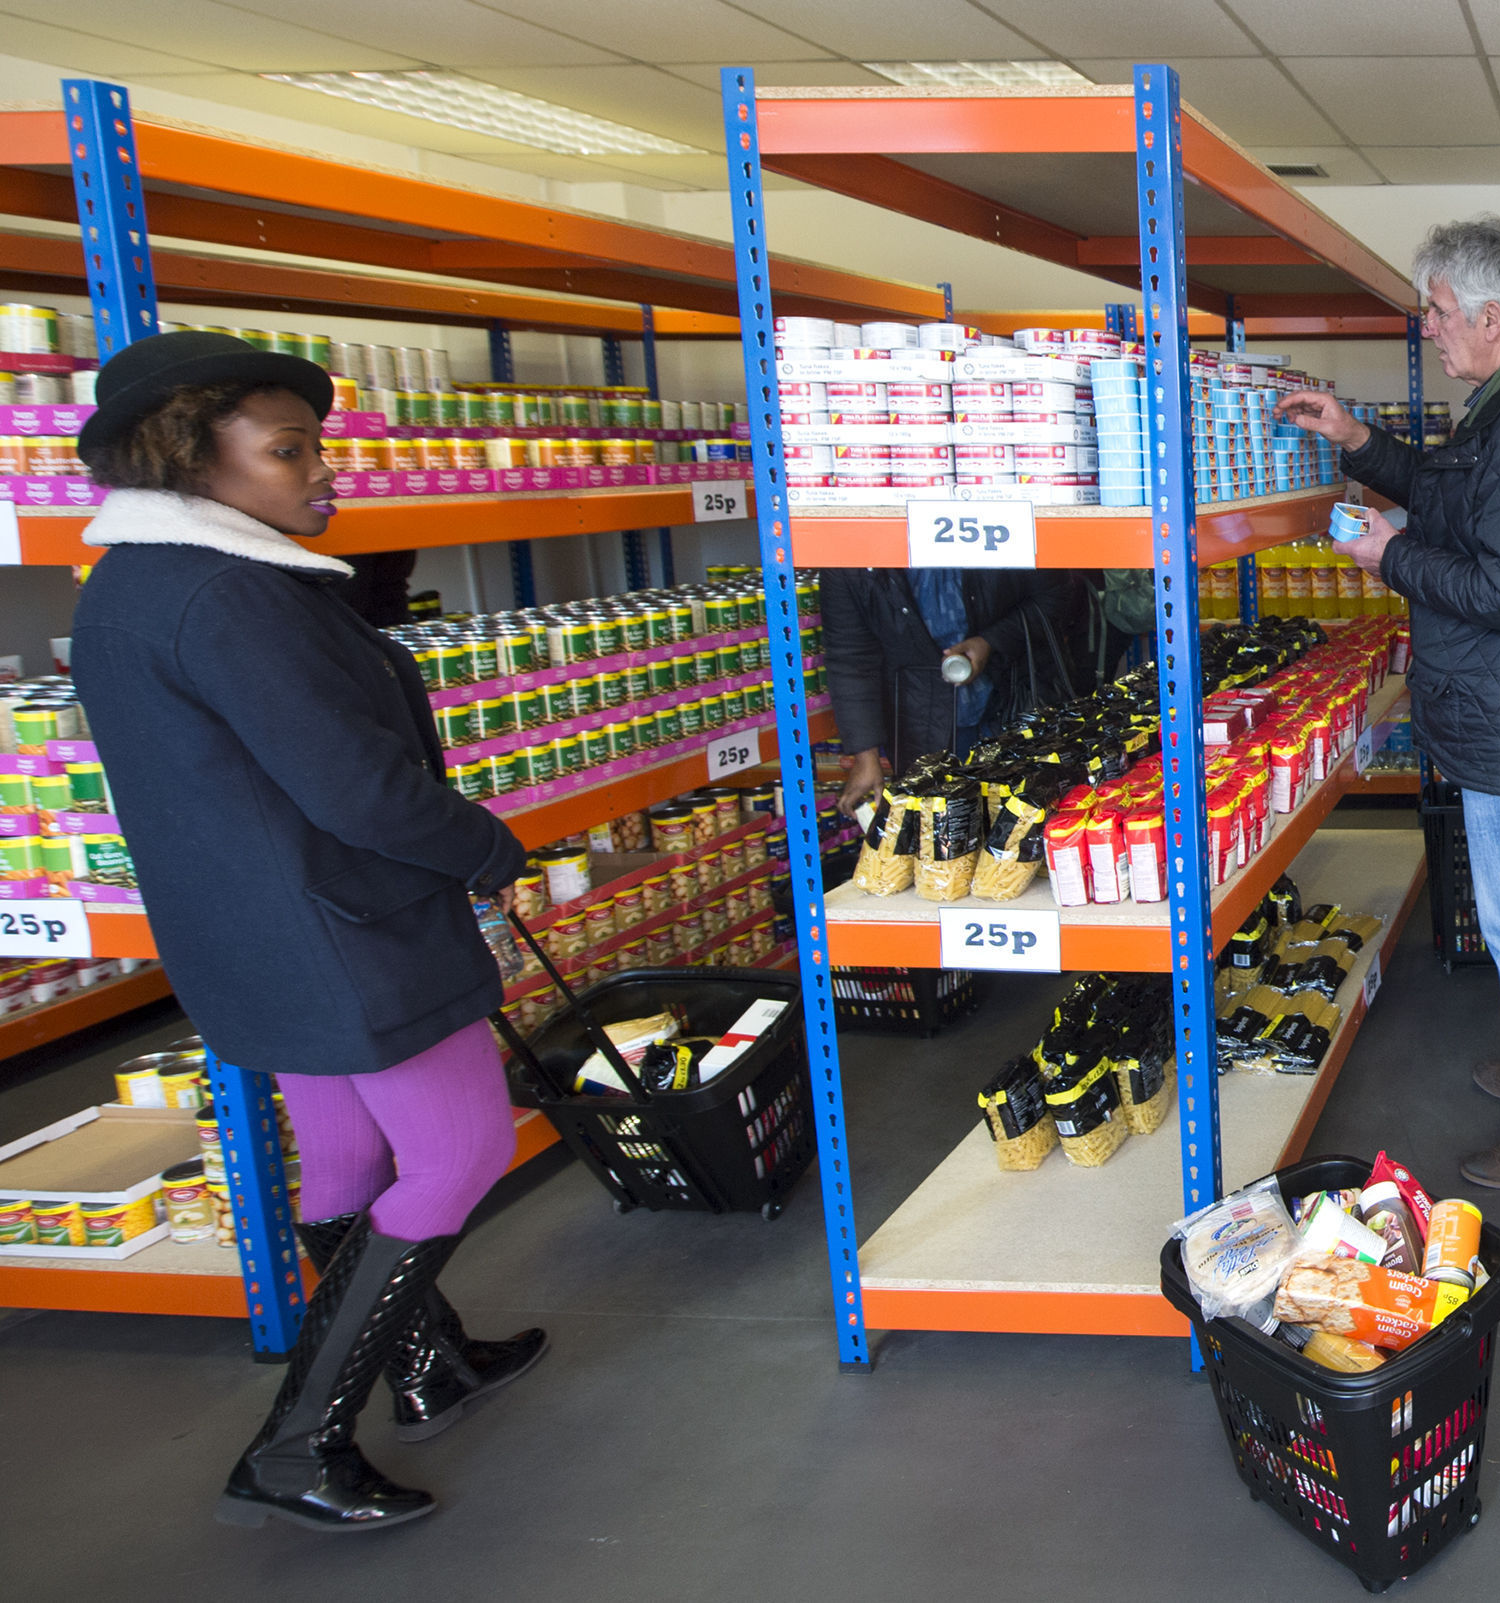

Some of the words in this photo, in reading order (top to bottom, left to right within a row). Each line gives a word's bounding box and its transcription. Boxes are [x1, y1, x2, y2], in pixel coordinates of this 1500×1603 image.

[704, 494, 736, 513] 25p
[933, 516, 1010, 551] 25p
[718, 745, 750, 767] 25p
[0, 913, 66, 942] 25p
[964, 922, 1037, 955] 25p
[1413, 1194, 1431, 1221] OLATE
[1386, 1269, 1429, 1288] Crackers
[1389, 1280, 1422, 1298] Cream
[1443, 1294, 1459, 1305] 85p
[1375, 1314, 1419, 1332] Crackers
[1377, 1323, 1412, 1338] Cream
